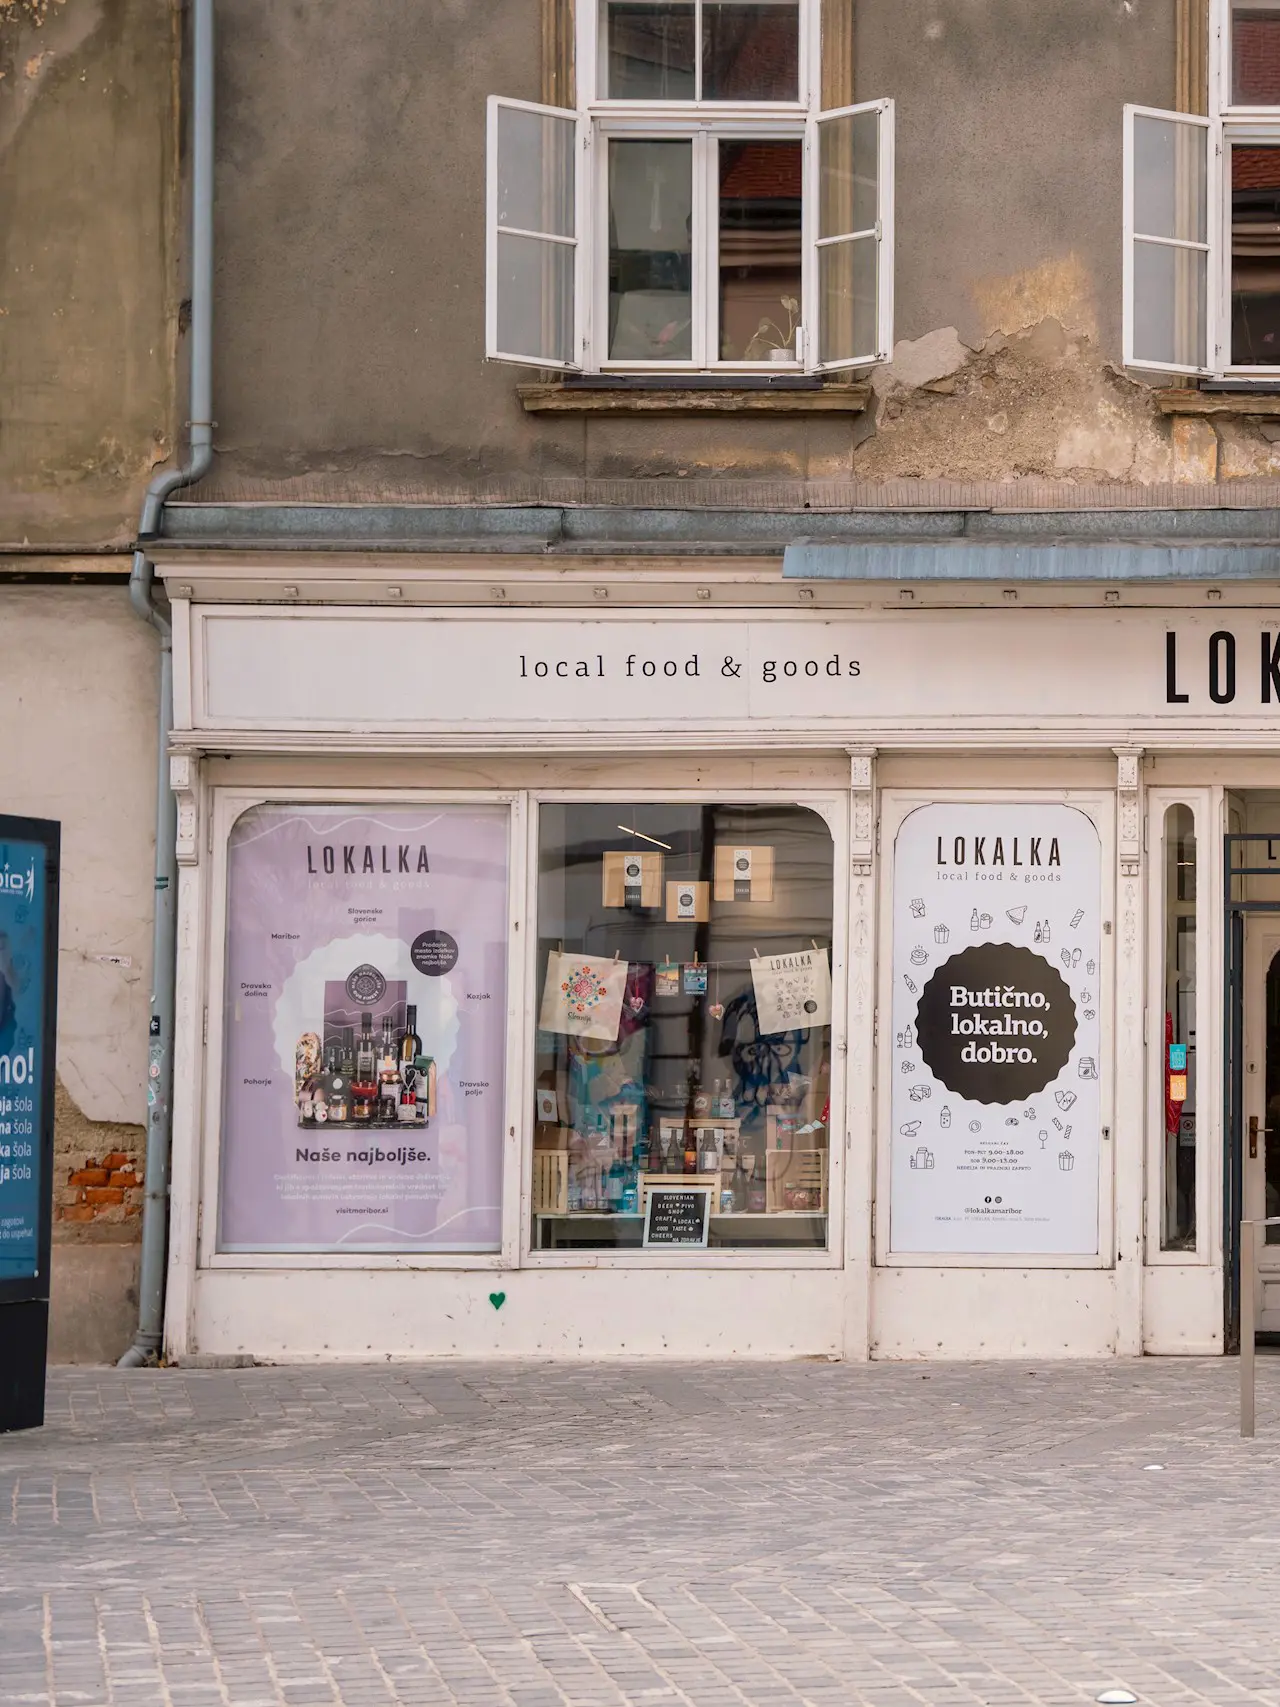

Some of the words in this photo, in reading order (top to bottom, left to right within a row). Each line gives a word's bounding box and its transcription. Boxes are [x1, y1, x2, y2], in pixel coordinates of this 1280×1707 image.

[518, 655, 606, 678] local
[625, 654, 701, 678] food
[720, 656, 743, 678] &
[762, 654, 862, 683] goods
[307, 844, 430, 874] LOKALKA
[937, 836, 1061, 866] LOKALKA
[936, 871, 968, 881] local
[975, 871, 1003, 881] food
[1009, 872, 1018, 881] &
[1024, 872, 1061, 884] goods
[353, 915, 377, 924] gorice
[271, 932, 301, 940] Maribor
[769, 954, 812, 971] LOKALKA
[466, 992, 491, 1001] Kozjak
[949, 985, 1051, 1012] Butično,
[950, 1013, 1049, 1039] lokalno,
[960, 1041, 1038, 1064] dobro.
[243, 1078, 272, 1087] Pohorje
[459, 1080, 490, 1088] Dravsko
[464, 1088, 483, 1097] polje
[14, 1096, 33, 1112] šola
[13, 1118, 32, 1135] šola
[12, 1141, 32, 1157] šola
[295, 1147, 342, 1162] Naše
[346, 1147, 431, 1166] najboljše.
[12, 1163, 32, 1180] šola
